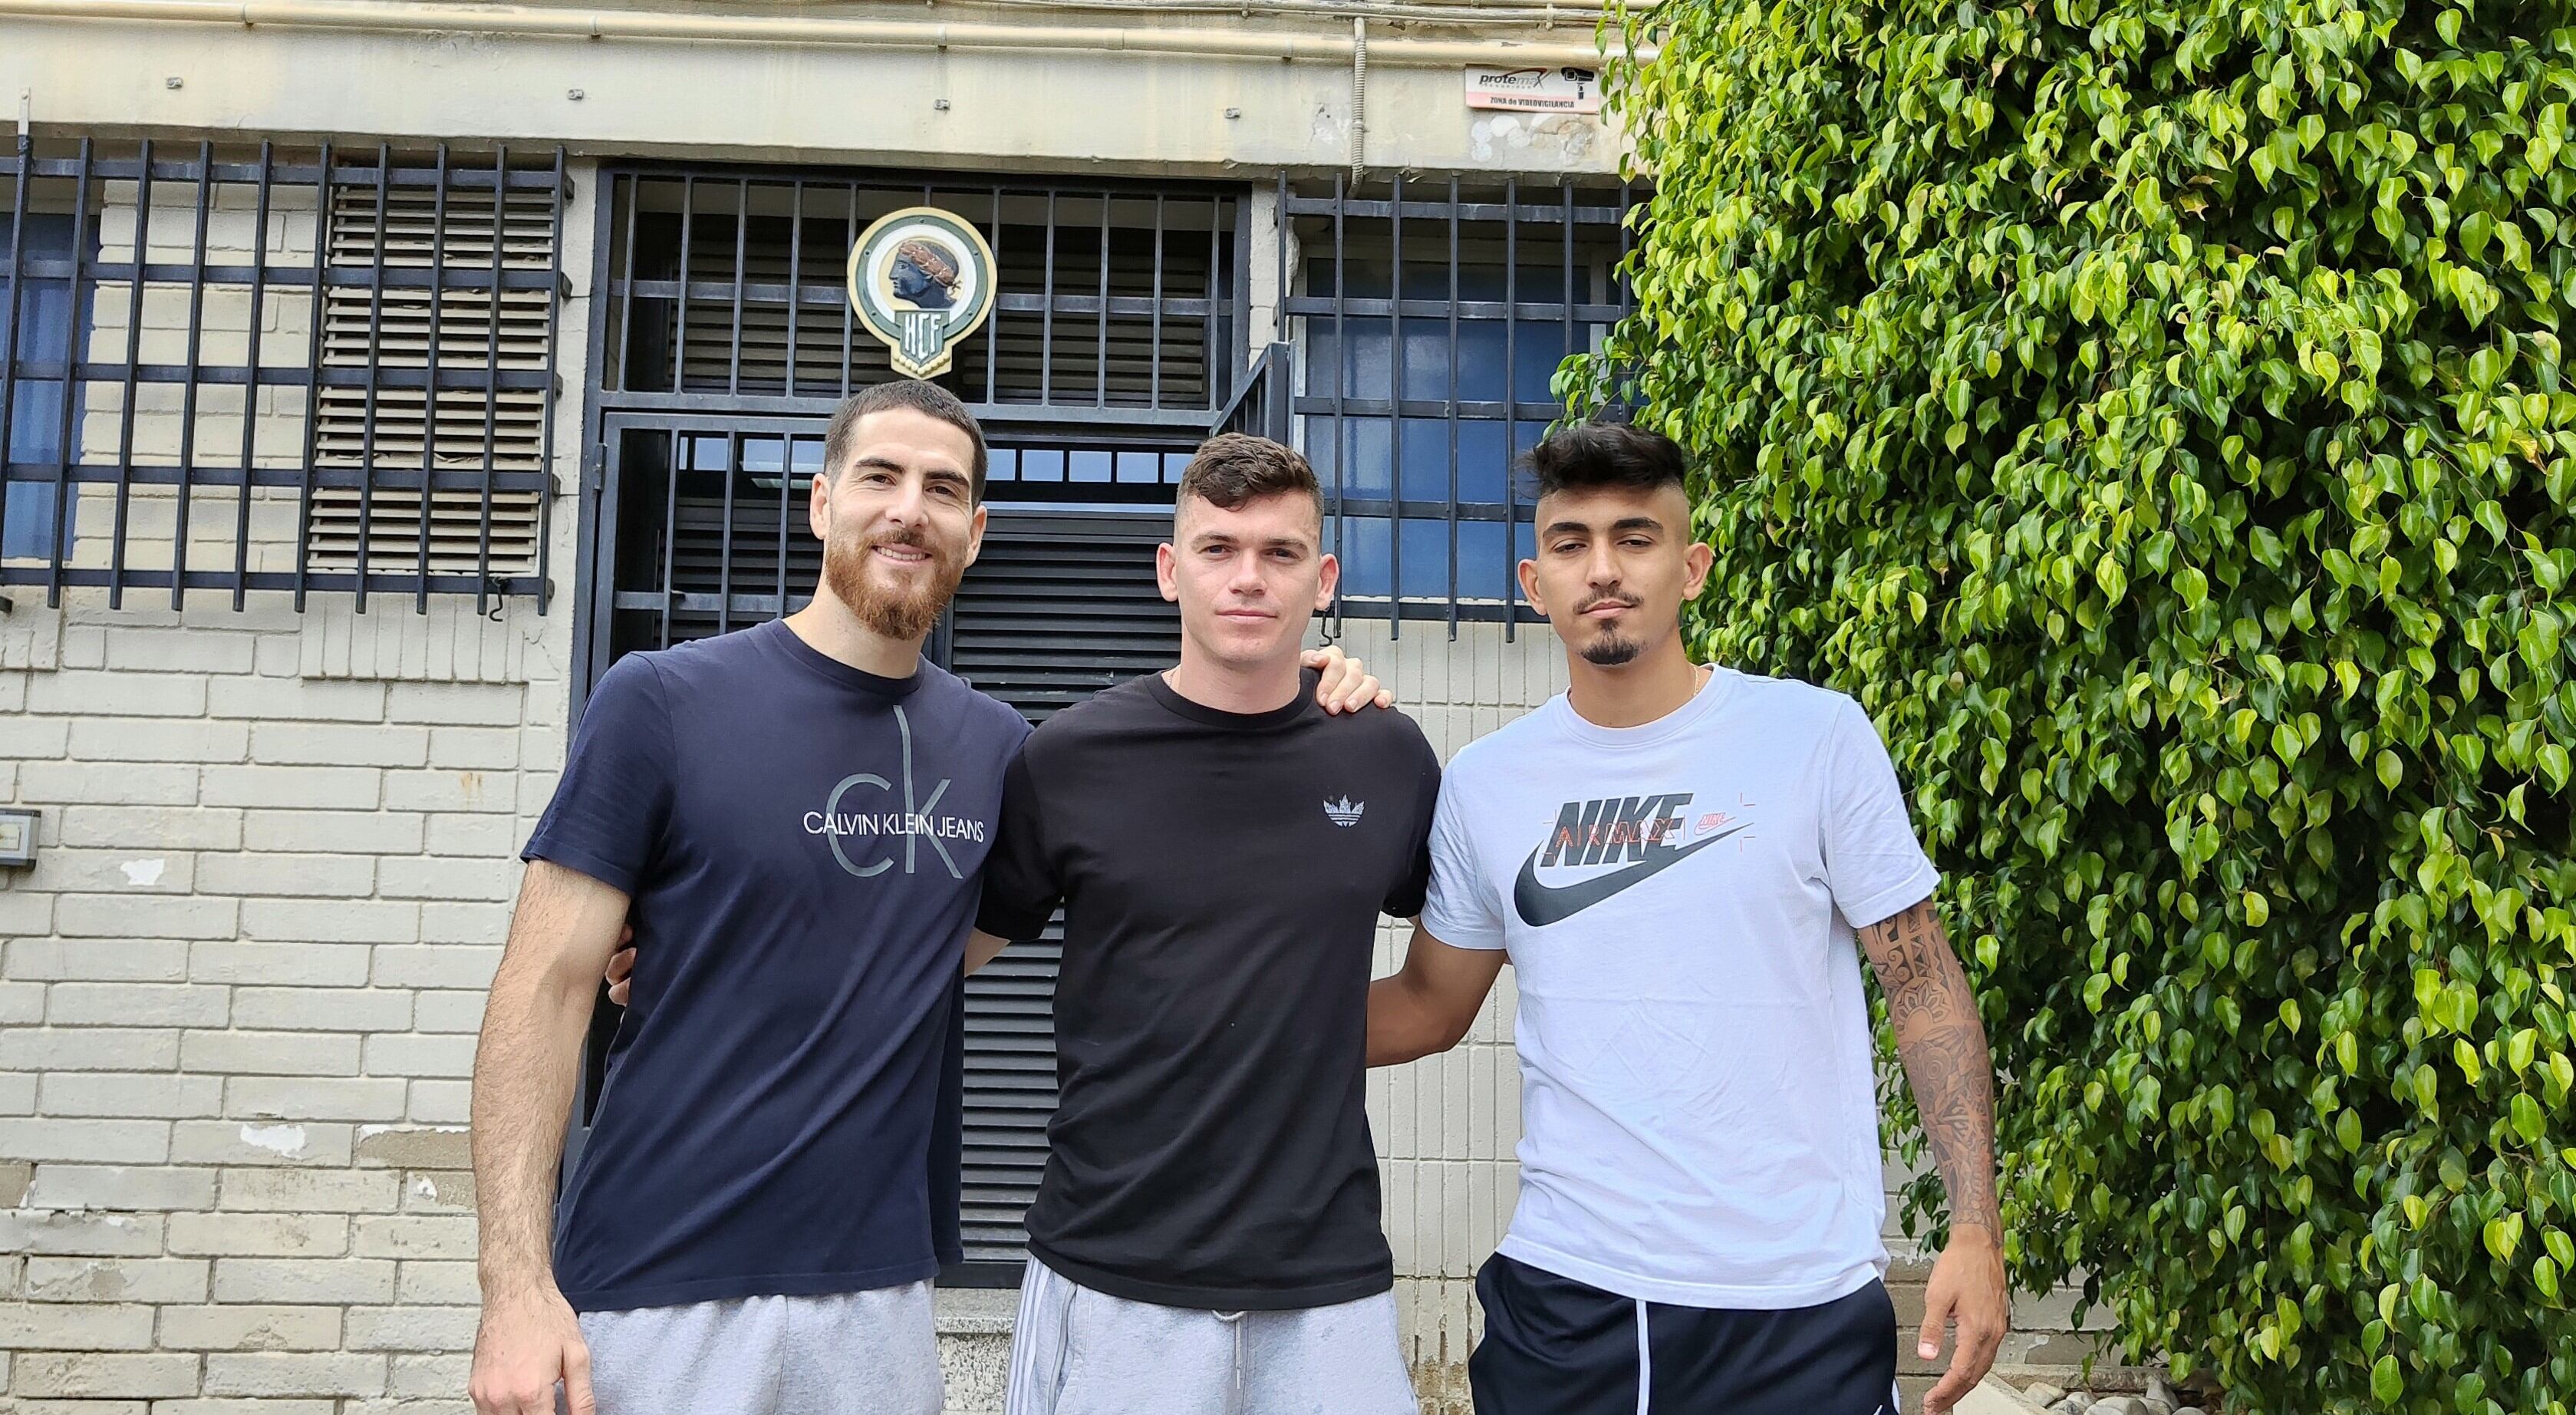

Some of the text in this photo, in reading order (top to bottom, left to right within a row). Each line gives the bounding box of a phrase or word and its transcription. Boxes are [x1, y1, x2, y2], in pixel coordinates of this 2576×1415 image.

[1518, 99, 1575, 108] VIDEOVIGILANCIA
[905, 313, 941, 359] HCF
[803, 811, 984, 843] CALVIN KLEIN JEANS
[1540, 793, 1694, 867] NIKE
[1701, 812, 1726, 826] NIKE
